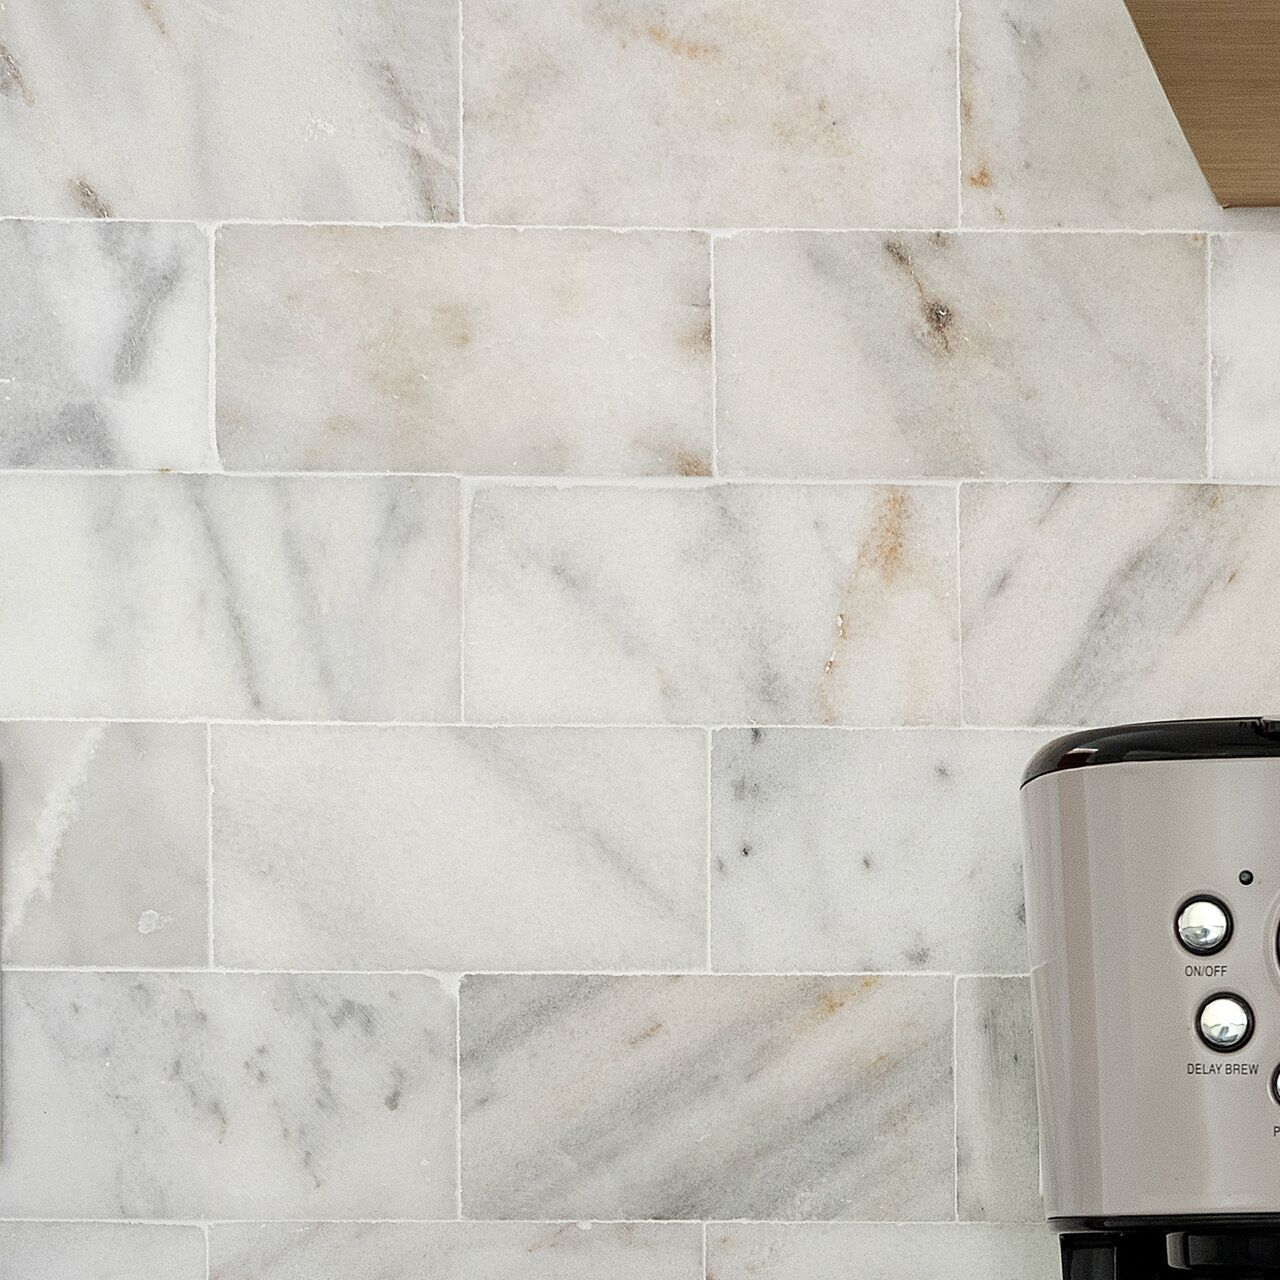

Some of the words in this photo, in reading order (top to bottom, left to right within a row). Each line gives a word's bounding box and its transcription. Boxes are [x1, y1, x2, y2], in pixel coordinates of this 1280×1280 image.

[1184, 965, 1228, 977] ON/OFF
[1186, 1063, 1223, 1075] DELAY
[1225, 1063, 1259, 1075] BREW
